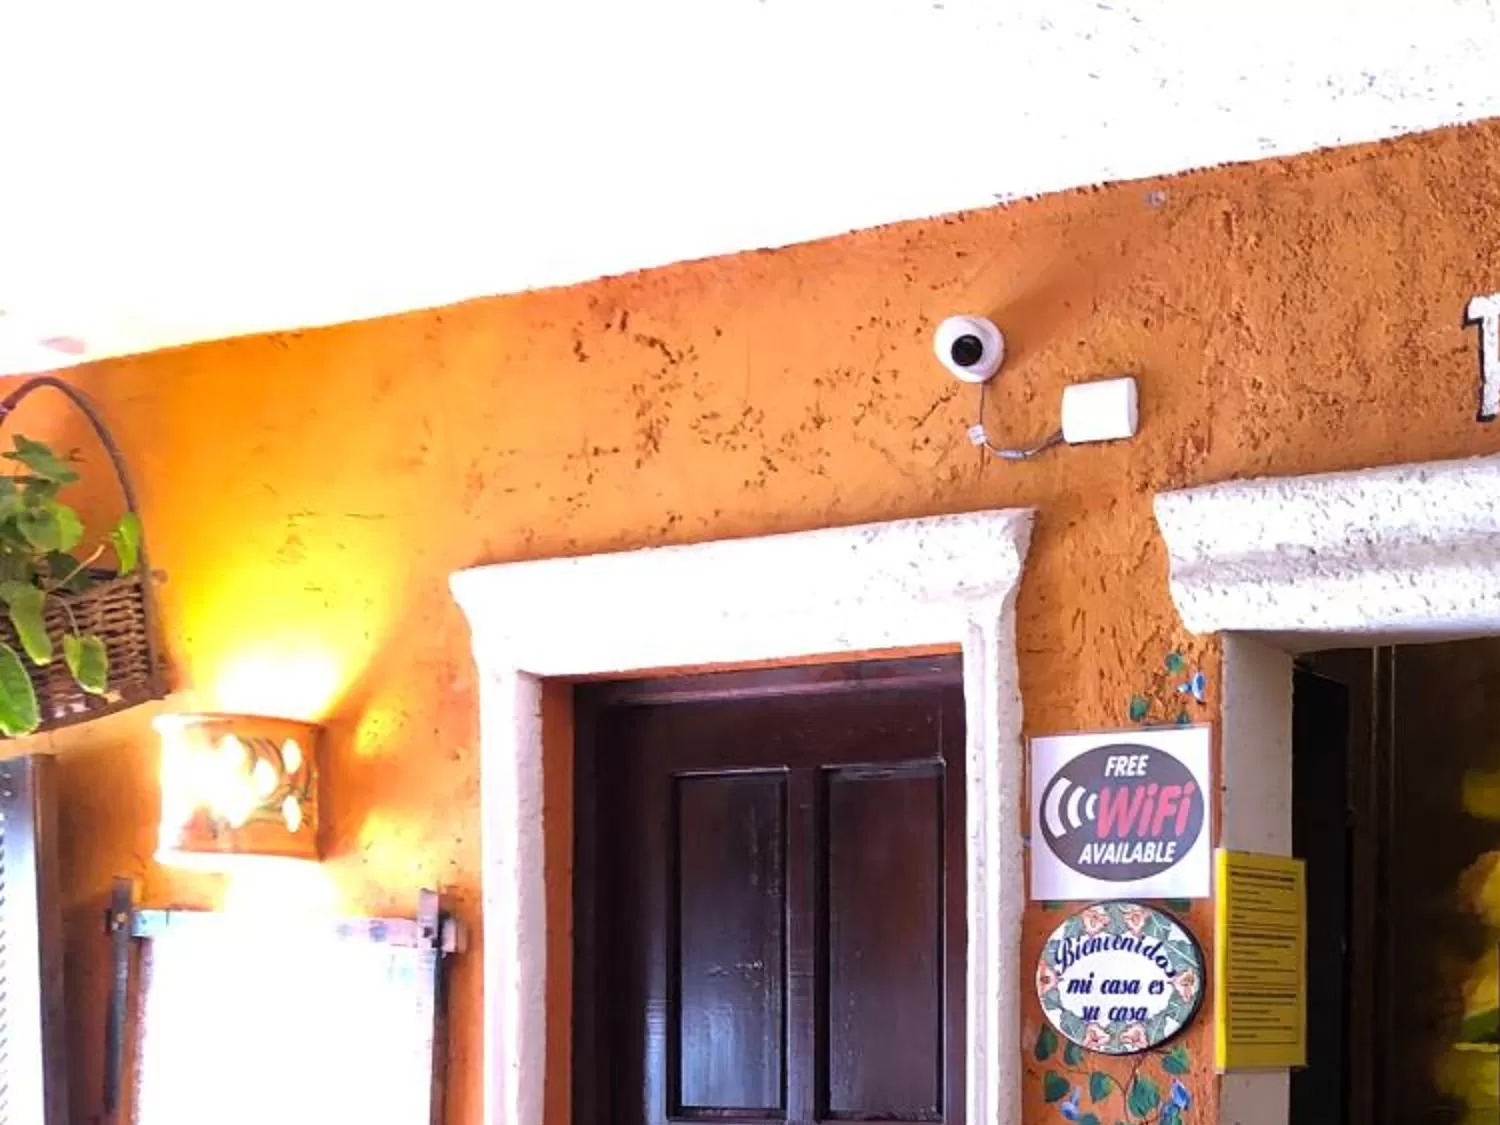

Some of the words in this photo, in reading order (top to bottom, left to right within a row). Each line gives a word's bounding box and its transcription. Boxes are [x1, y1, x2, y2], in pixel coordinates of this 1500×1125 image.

[1104, 755, 1149, 777] FREE
[1095, 782, 1196, 838] WiFi
[1078, 841, 1177, 865] AVAILABLE
[1054, 934, 1176, 979] Bienvenidos
[1066, 973, 1094, 995] mi
[1100, 977, 1142, 995] casa
[1147, 978, 1165, 995] es
[1080, 1005, 1104, 1022] su
[1108, 1005, 1148, 1022] casa
